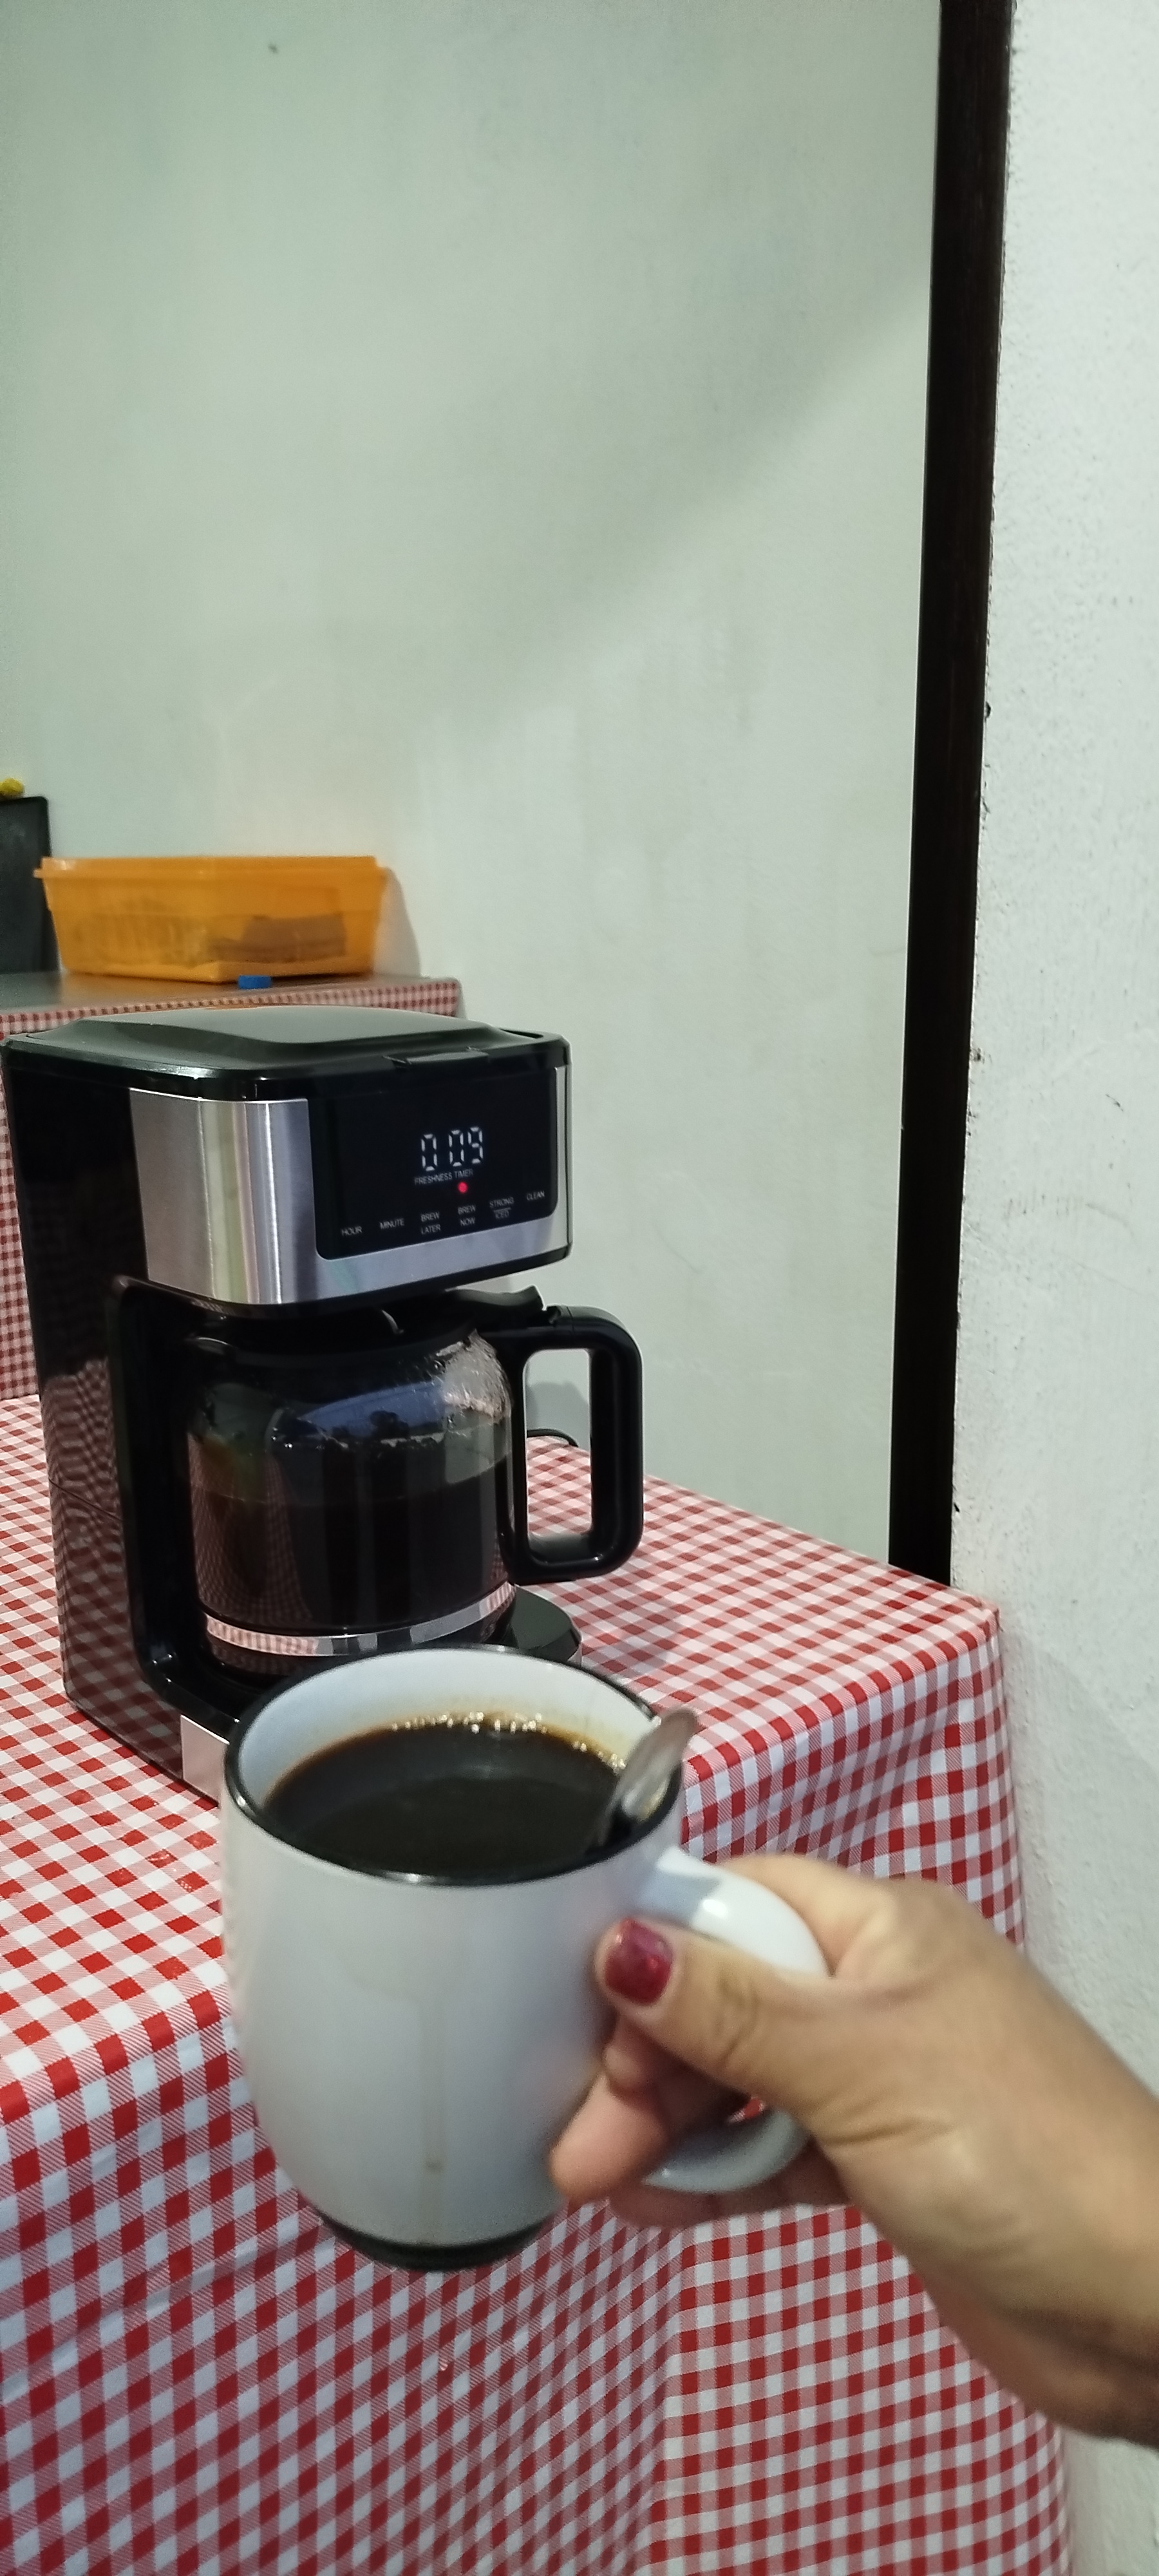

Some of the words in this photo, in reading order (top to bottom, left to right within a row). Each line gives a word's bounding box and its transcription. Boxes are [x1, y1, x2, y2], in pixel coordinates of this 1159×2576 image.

[414, 1172, 453, 1185] FRESHNESS
[454, 1169, 473, 1178] TIMER
[526, 1191, 545, 1200] CLEAN
[489, 1197, 514, 1208] STRONG
[458, 1205, 476, 1214] BREW
[420, 1212, 440, 1222] BREW
[460, 1217, 475, 1226] NOW
[379, 1218, 405, 1229] MINUTE
[341, 1226, 362, 1236] HOUR
[420, 1224, 441, 1234] LATER
